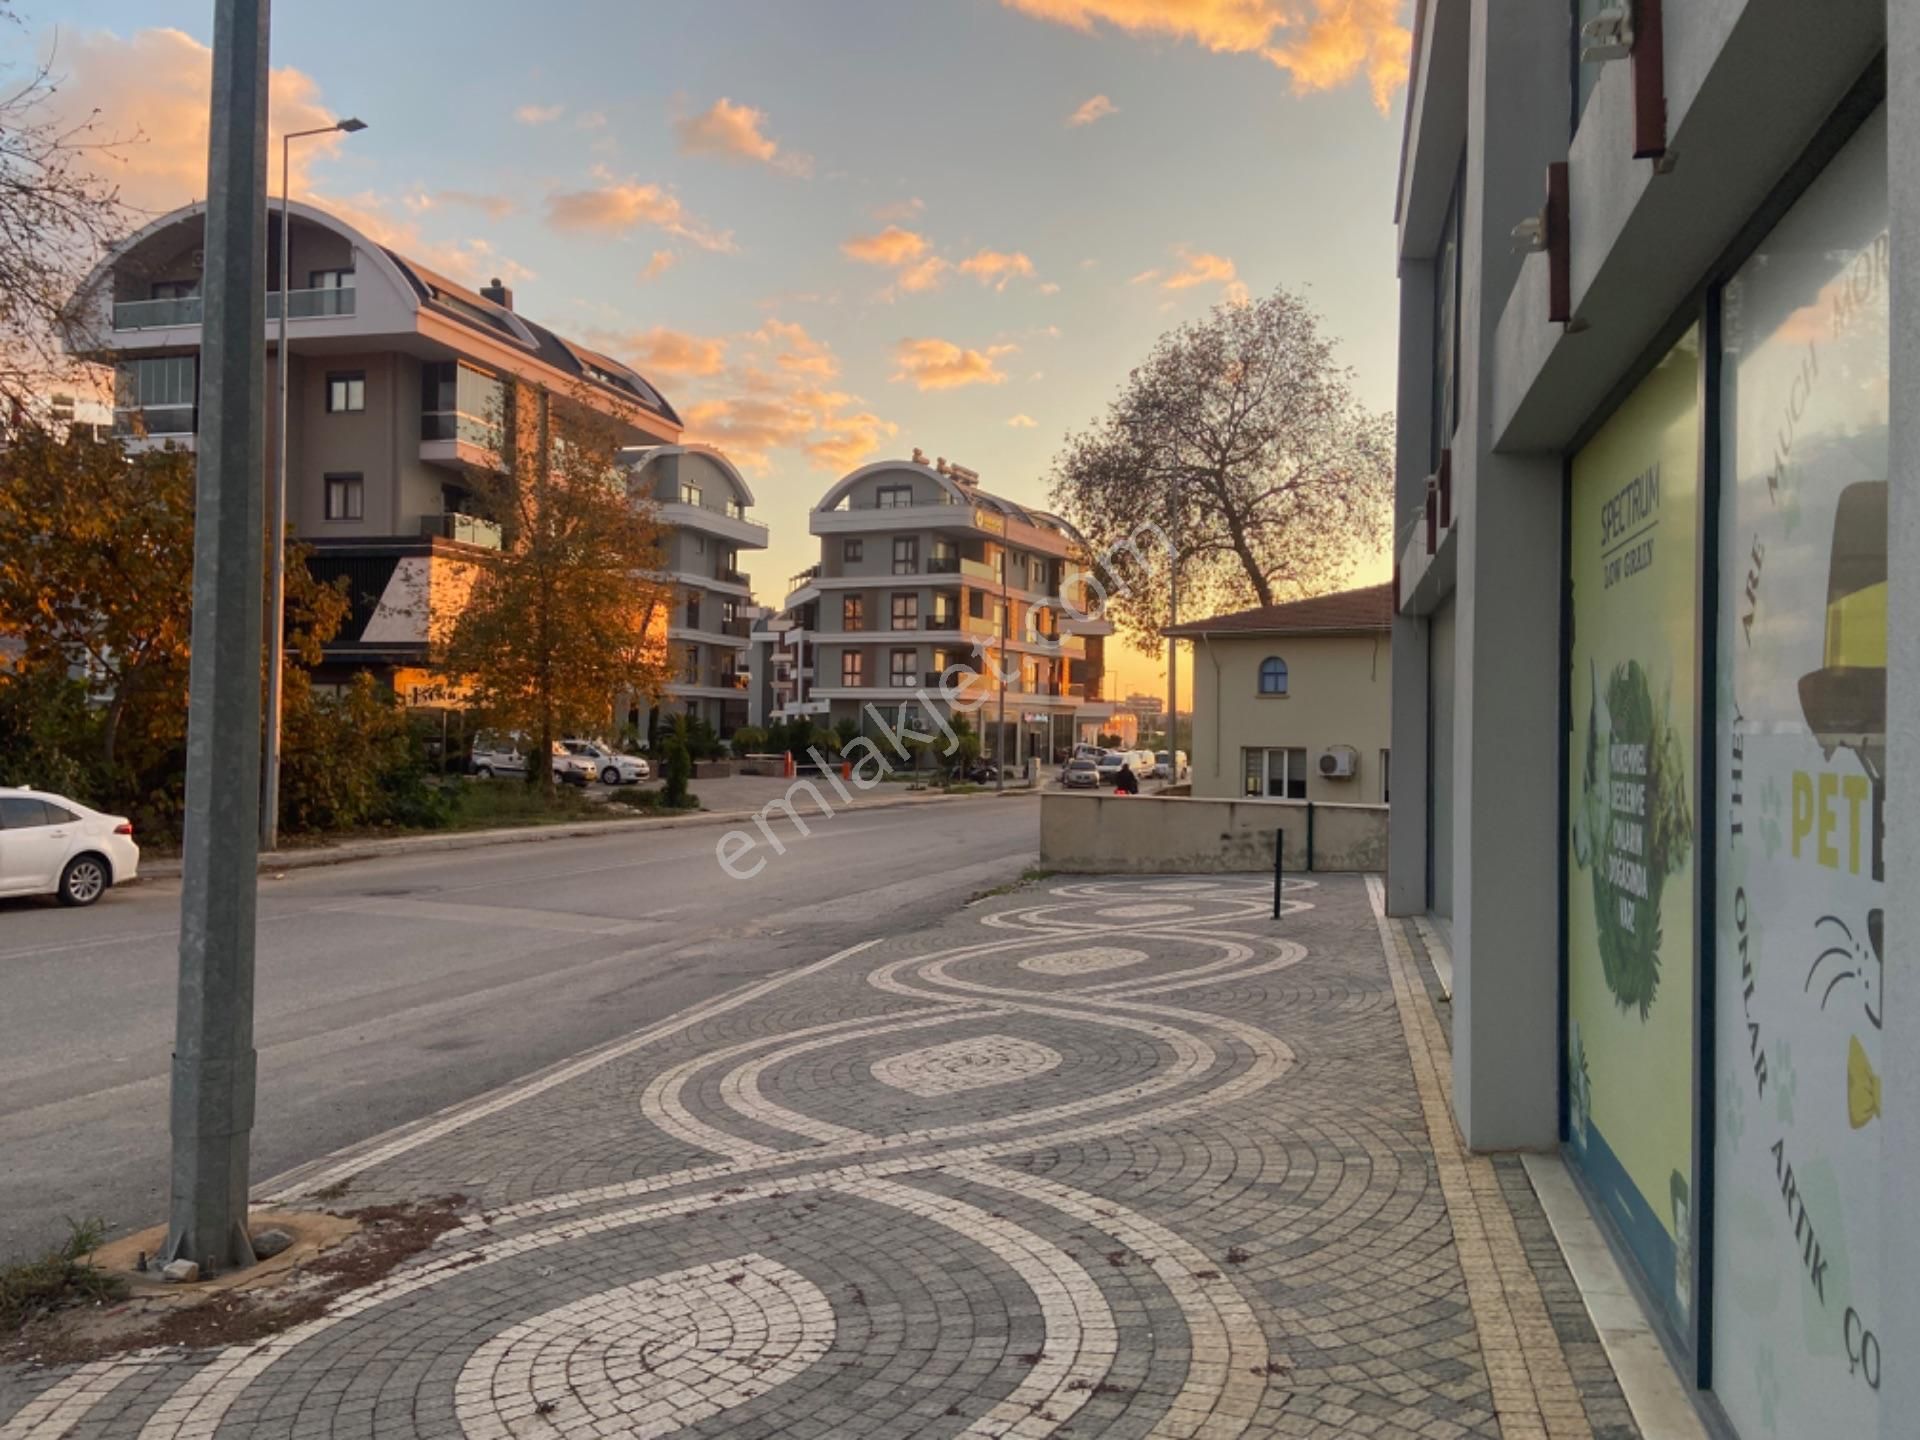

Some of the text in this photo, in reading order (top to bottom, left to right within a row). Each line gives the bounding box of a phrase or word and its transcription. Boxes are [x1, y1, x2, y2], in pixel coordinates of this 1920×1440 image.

[1601, 459, 1660, 547] SPECTRUM
[1603, 538, 1655, 590] LOW GRAIN
[1730, 702, 1745, 849] THEY
[1742, 532, 1765, 648] ARE
[1766, 338, 1819, 505] MUCH
[1734, 885, 1881, 1391] ONLAR ARTIK ÇO
